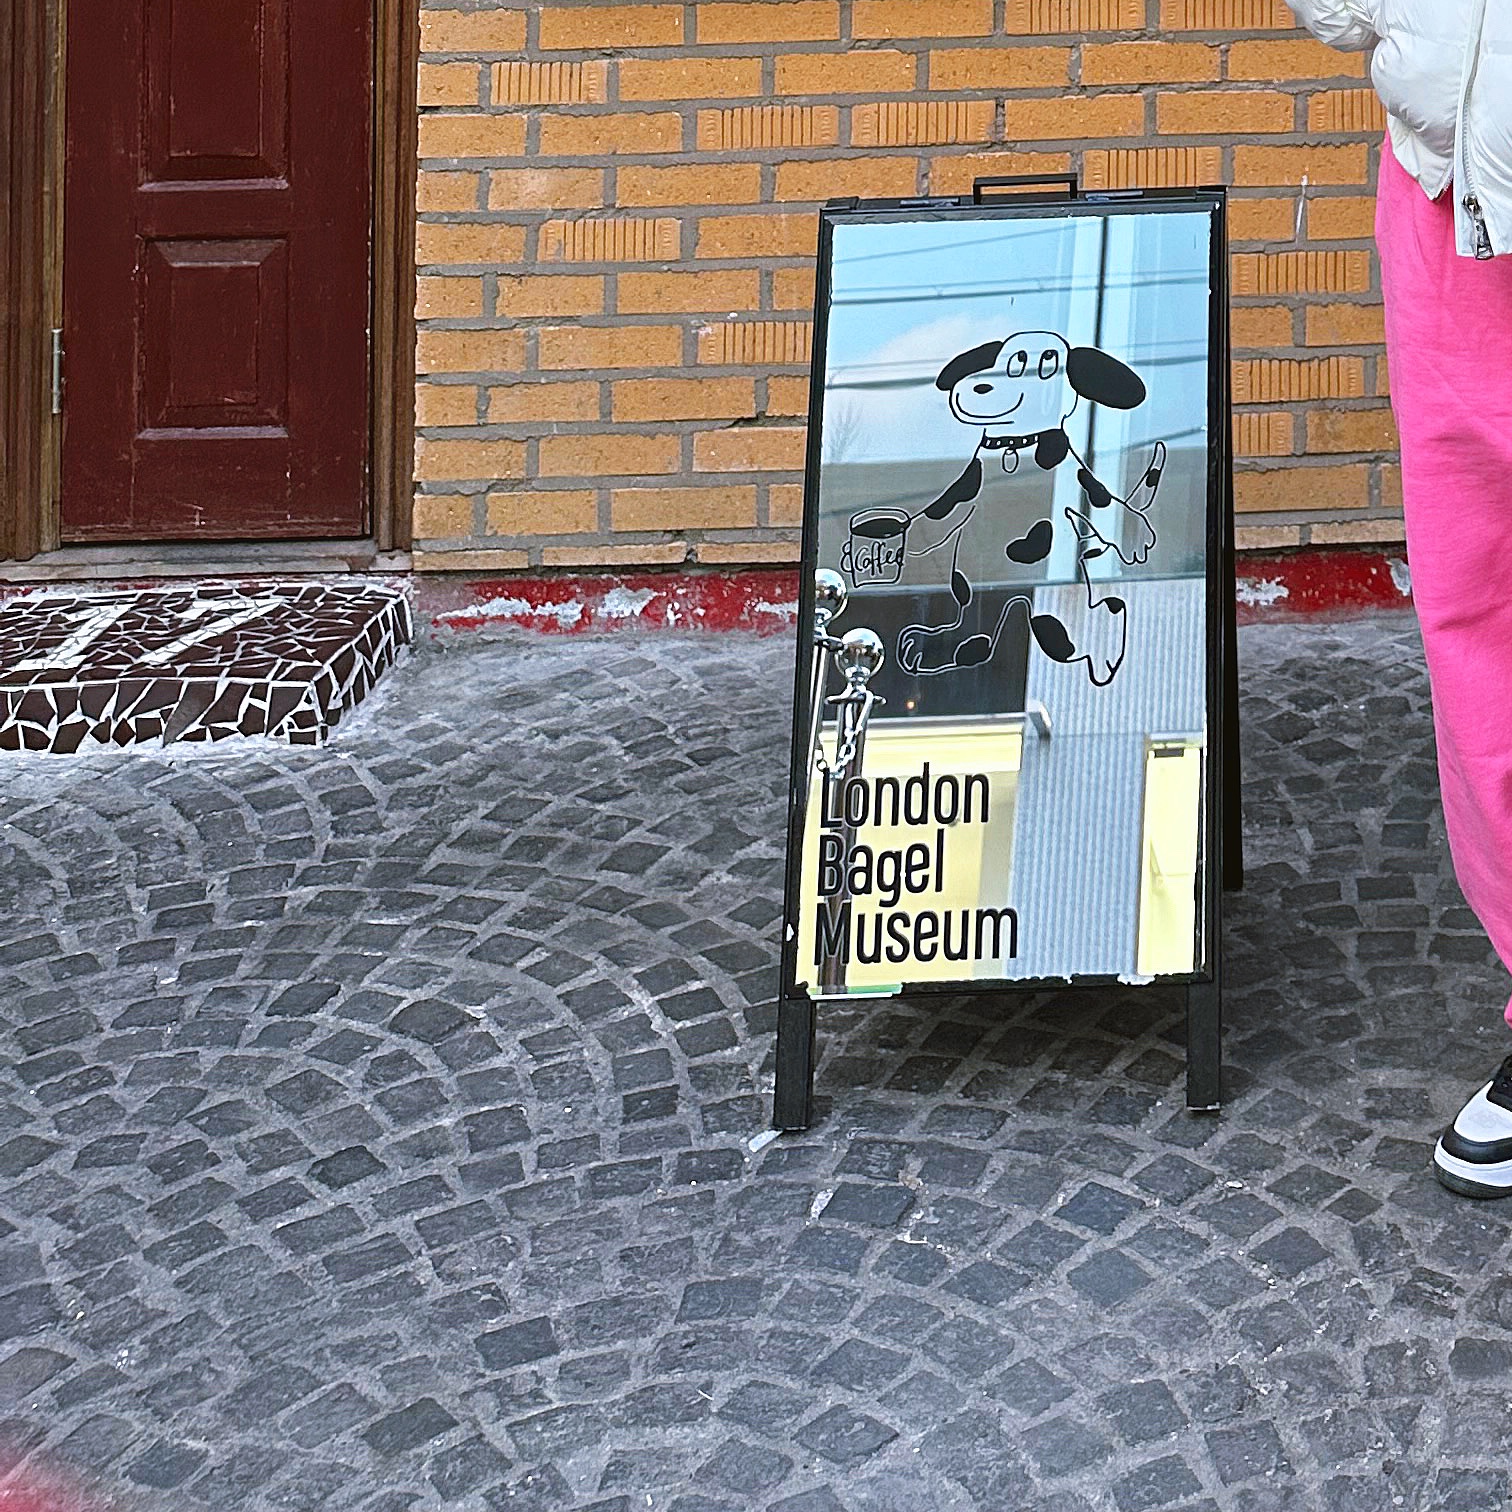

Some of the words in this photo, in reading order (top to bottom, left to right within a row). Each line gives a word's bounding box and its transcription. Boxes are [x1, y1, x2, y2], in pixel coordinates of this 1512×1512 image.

[818, 761, 990, 834] London
[816, 829, 946, 907] Bagel
[812, 904, 1019, 967] Museum
